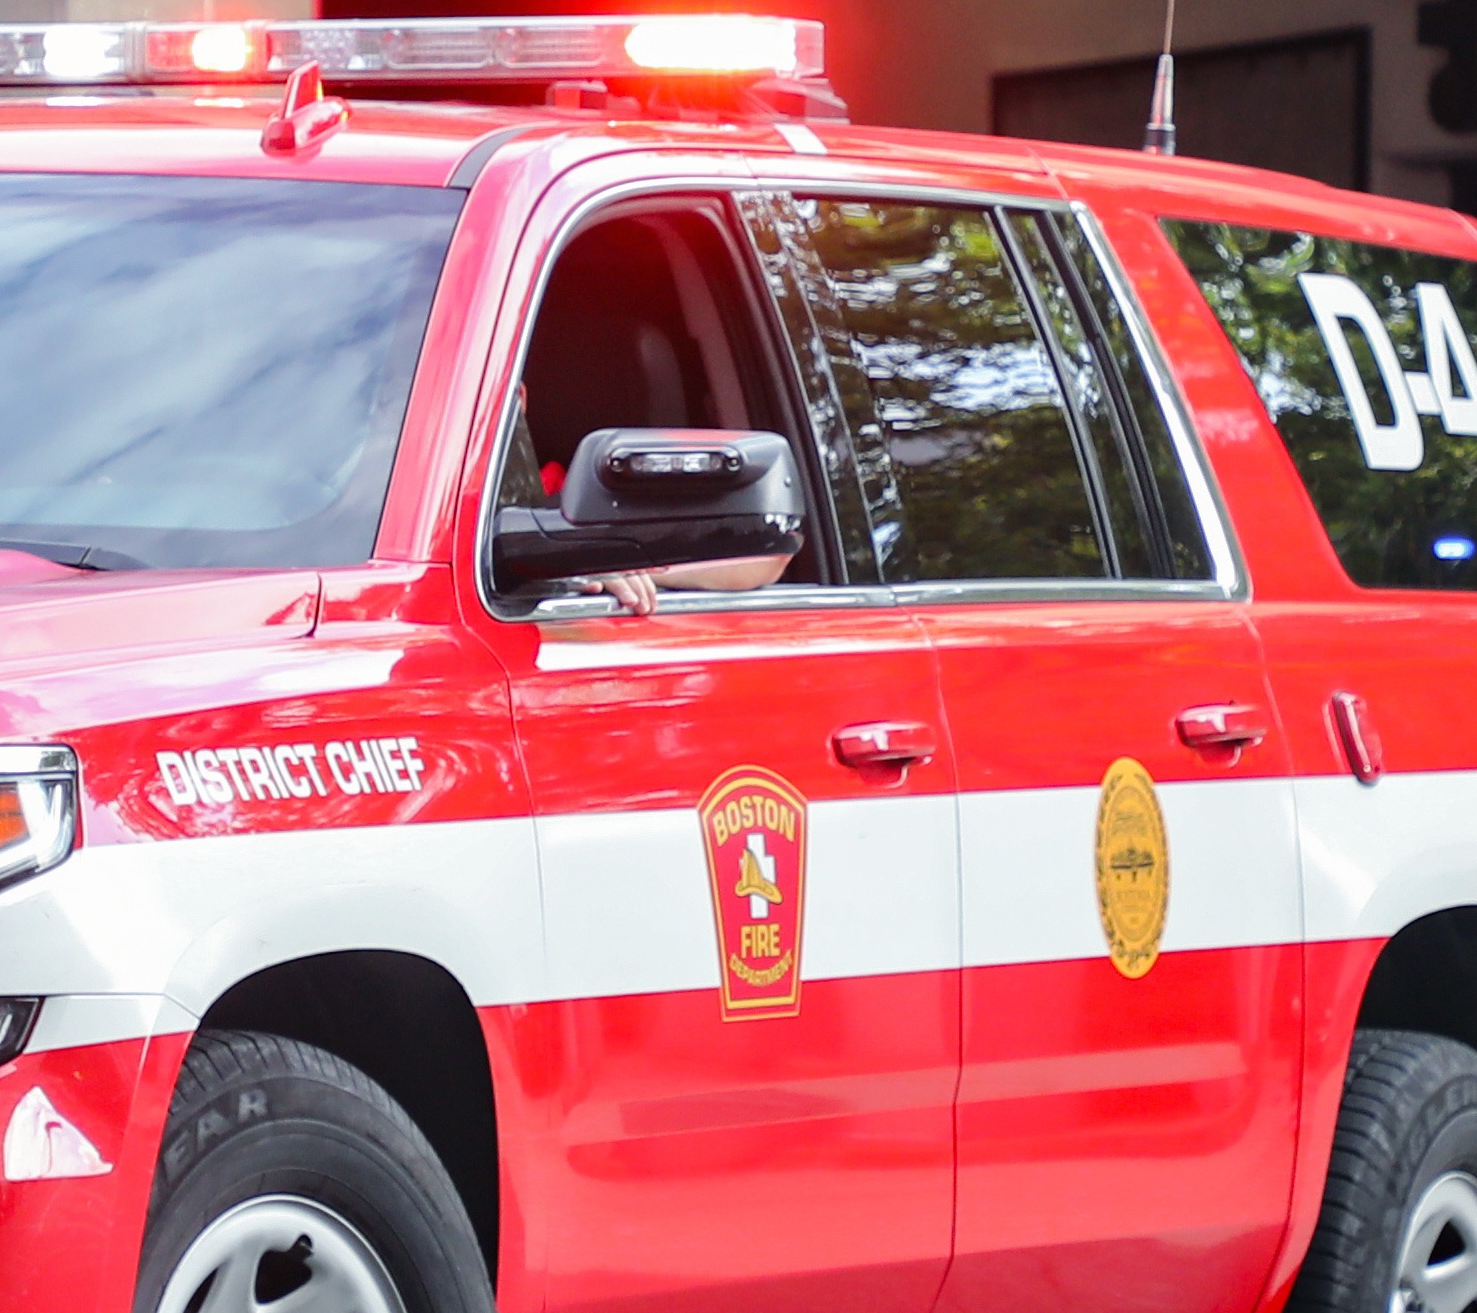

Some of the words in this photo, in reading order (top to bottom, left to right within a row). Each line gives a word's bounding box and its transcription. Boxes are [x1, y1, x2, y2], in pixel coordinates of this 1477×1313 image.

[154, 744, 329, 806] DISTRICT
[324, 737, 426, 795] CHIEF
[713, 795, 795, 847] BOSTON
[740, 923, 782, 959] FIRE
